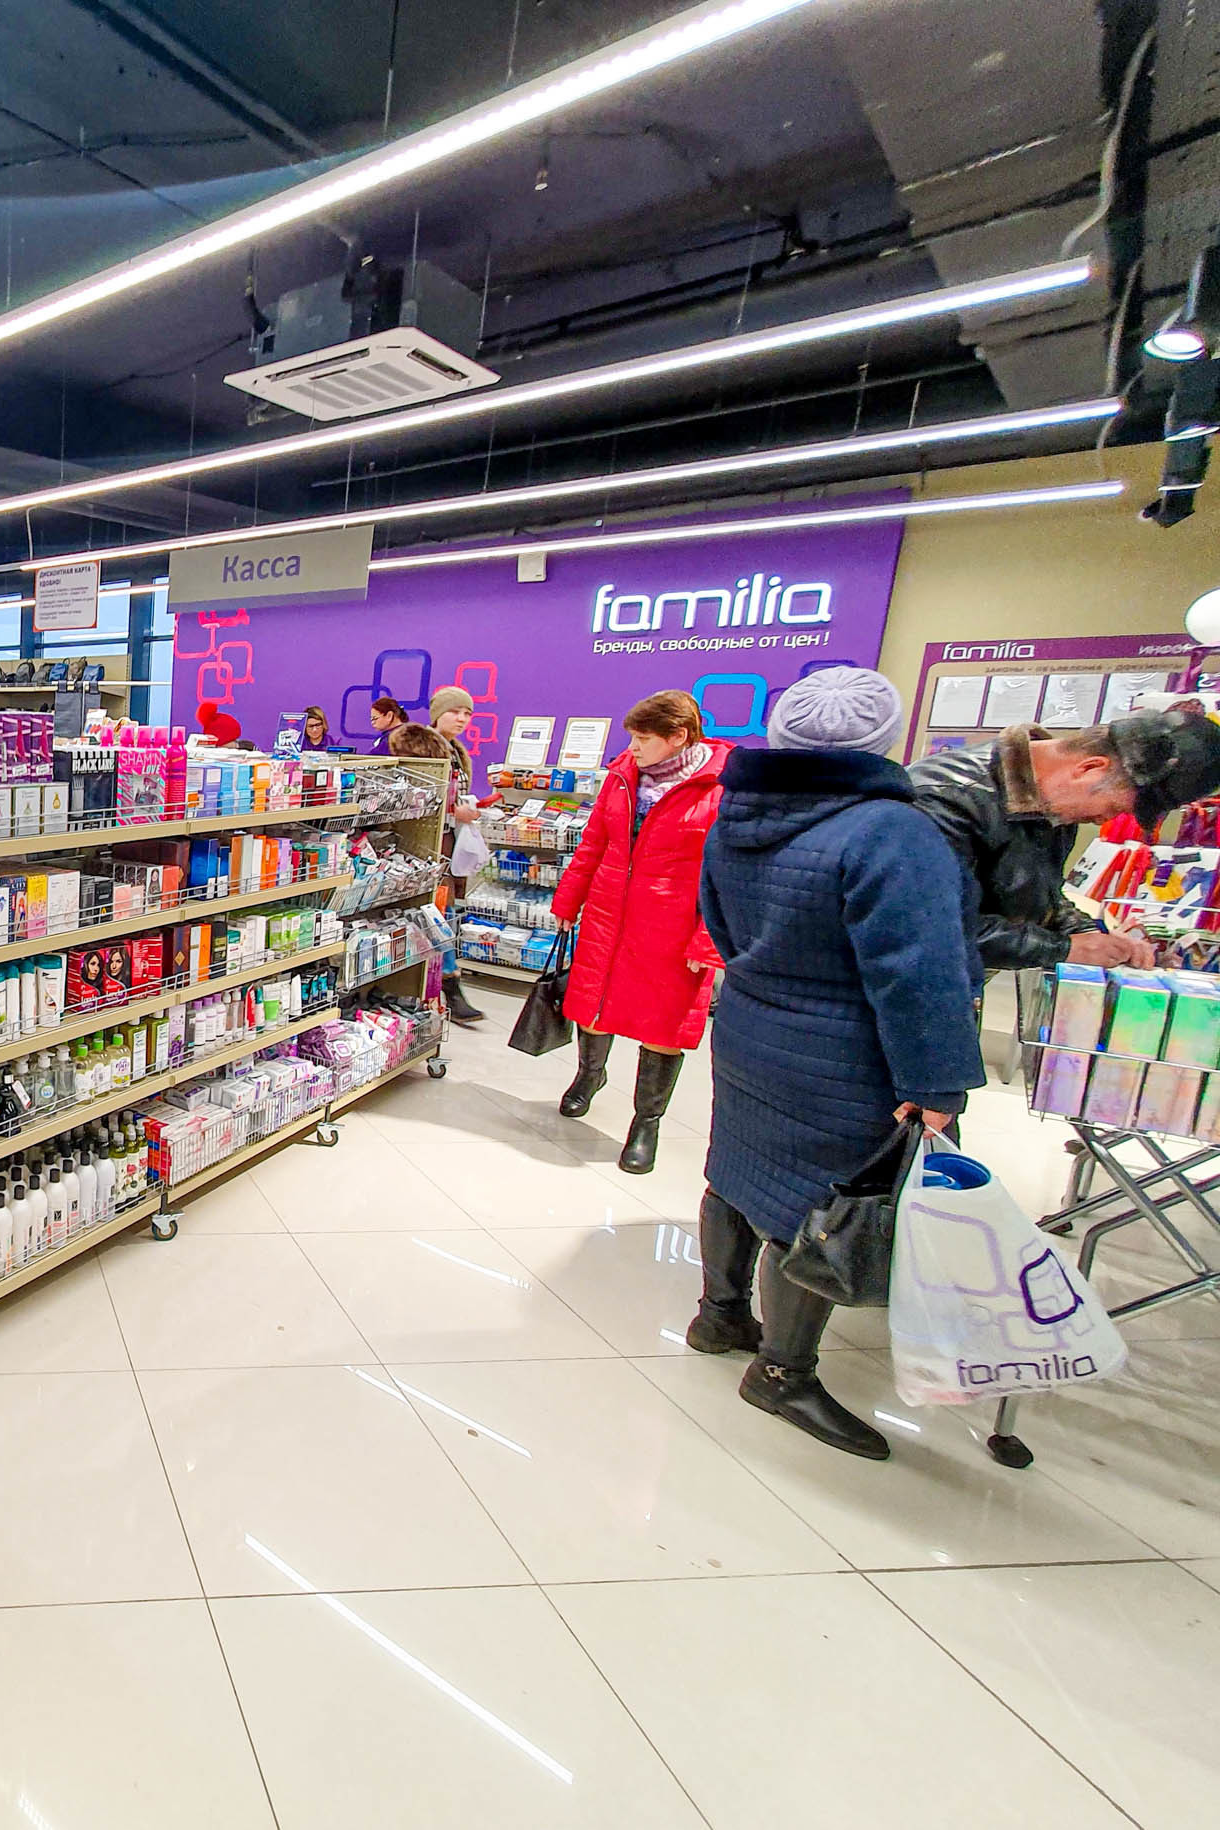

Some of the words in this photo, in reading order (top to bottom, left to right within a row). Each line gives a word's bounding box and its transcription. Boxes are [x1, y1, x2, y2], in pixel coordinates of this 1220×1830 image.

[222, 555, 300, 583] Касса
[592, 573, 832, 633] familia
[592, 639, 656, 655] Бренды,
[659, 637, 754, 652] свободные
[758, 635, 780, 649] от
[942, 642, 1035, 660] familia
[72, 759, 97, 772] BLACK
[142, 765, 160, 774] LOVE
[956, 1354, 1098, 1387] familia
